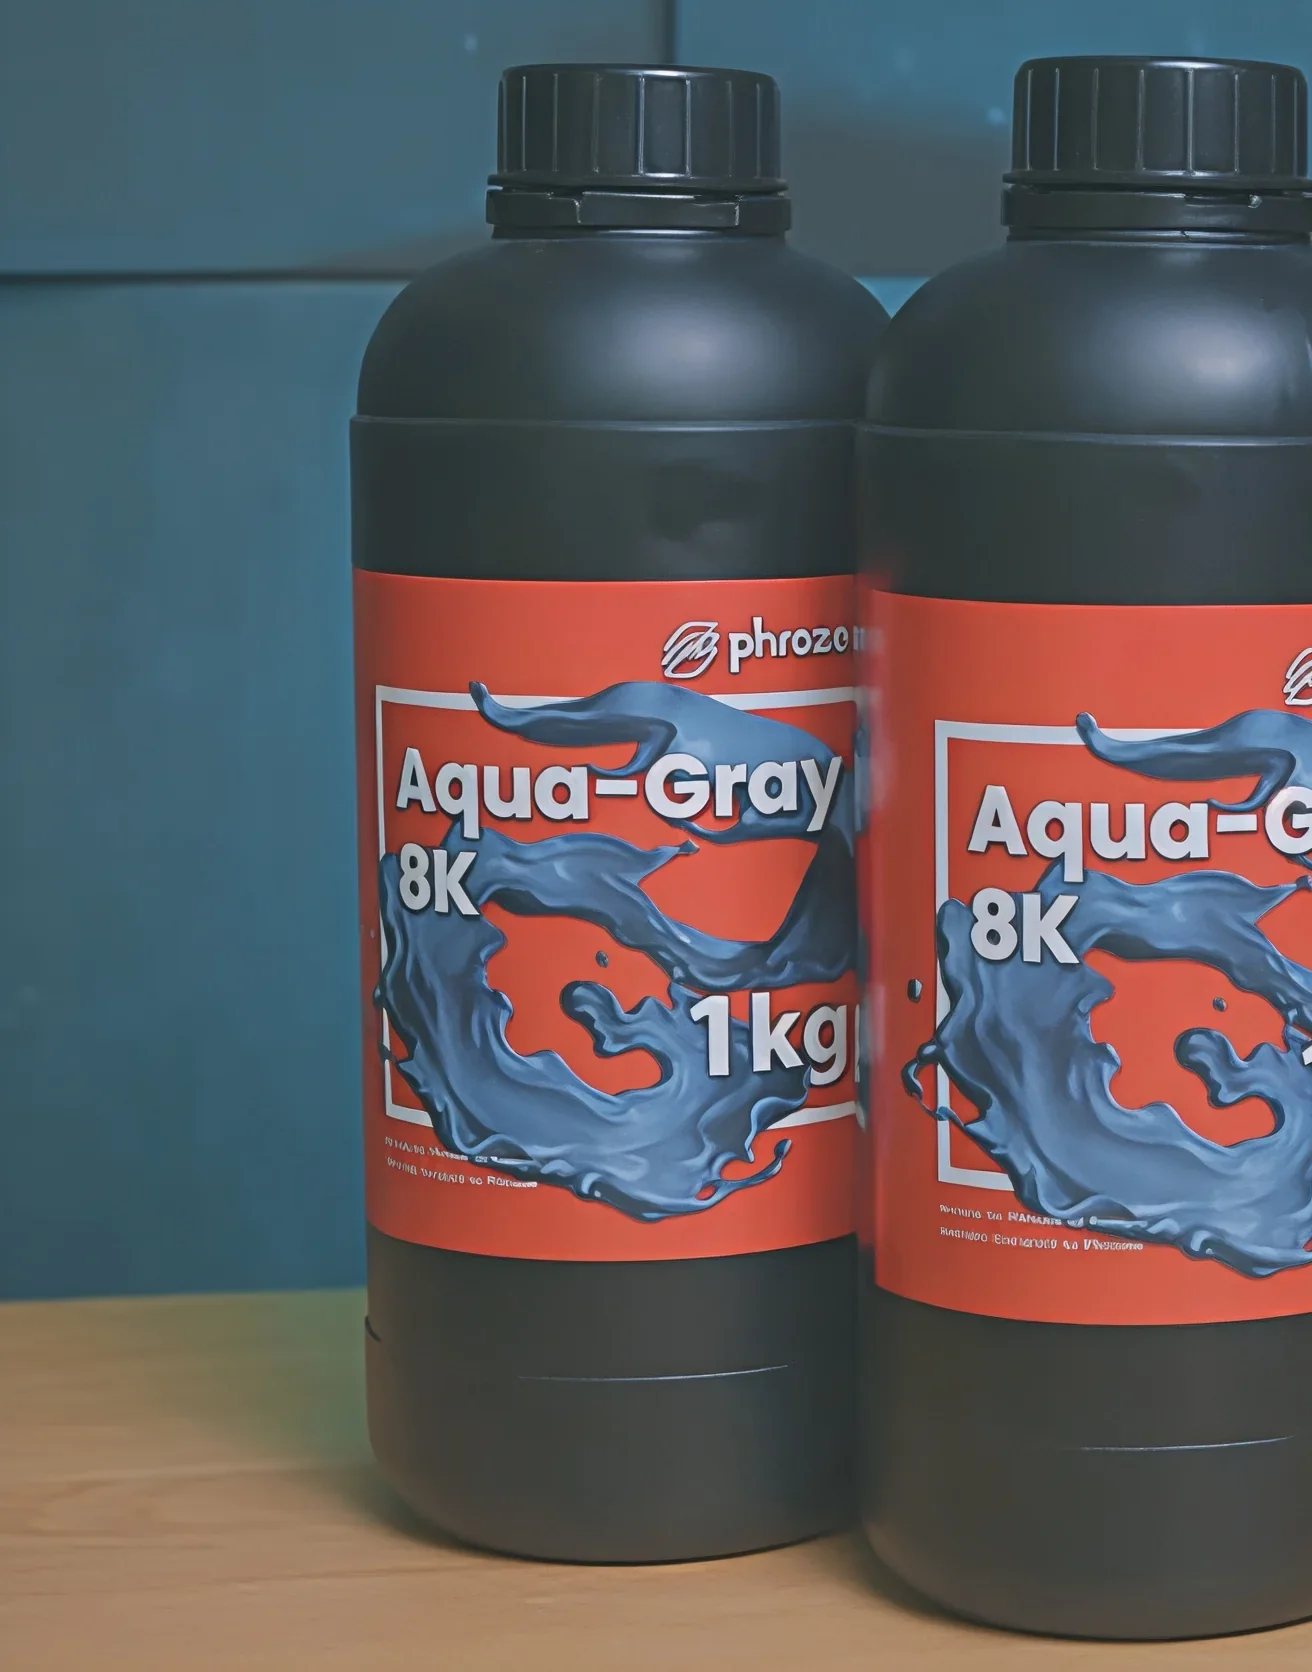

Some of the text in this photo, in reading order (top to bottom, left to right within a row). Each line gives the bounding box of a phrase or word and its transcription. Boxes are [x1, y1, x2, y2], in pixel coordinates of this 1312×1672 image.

[396, 747, 843, 839] Aqua-Gray
[399, 843, 480, 916] 8K
[970, 888, 1080, 965] 8K
